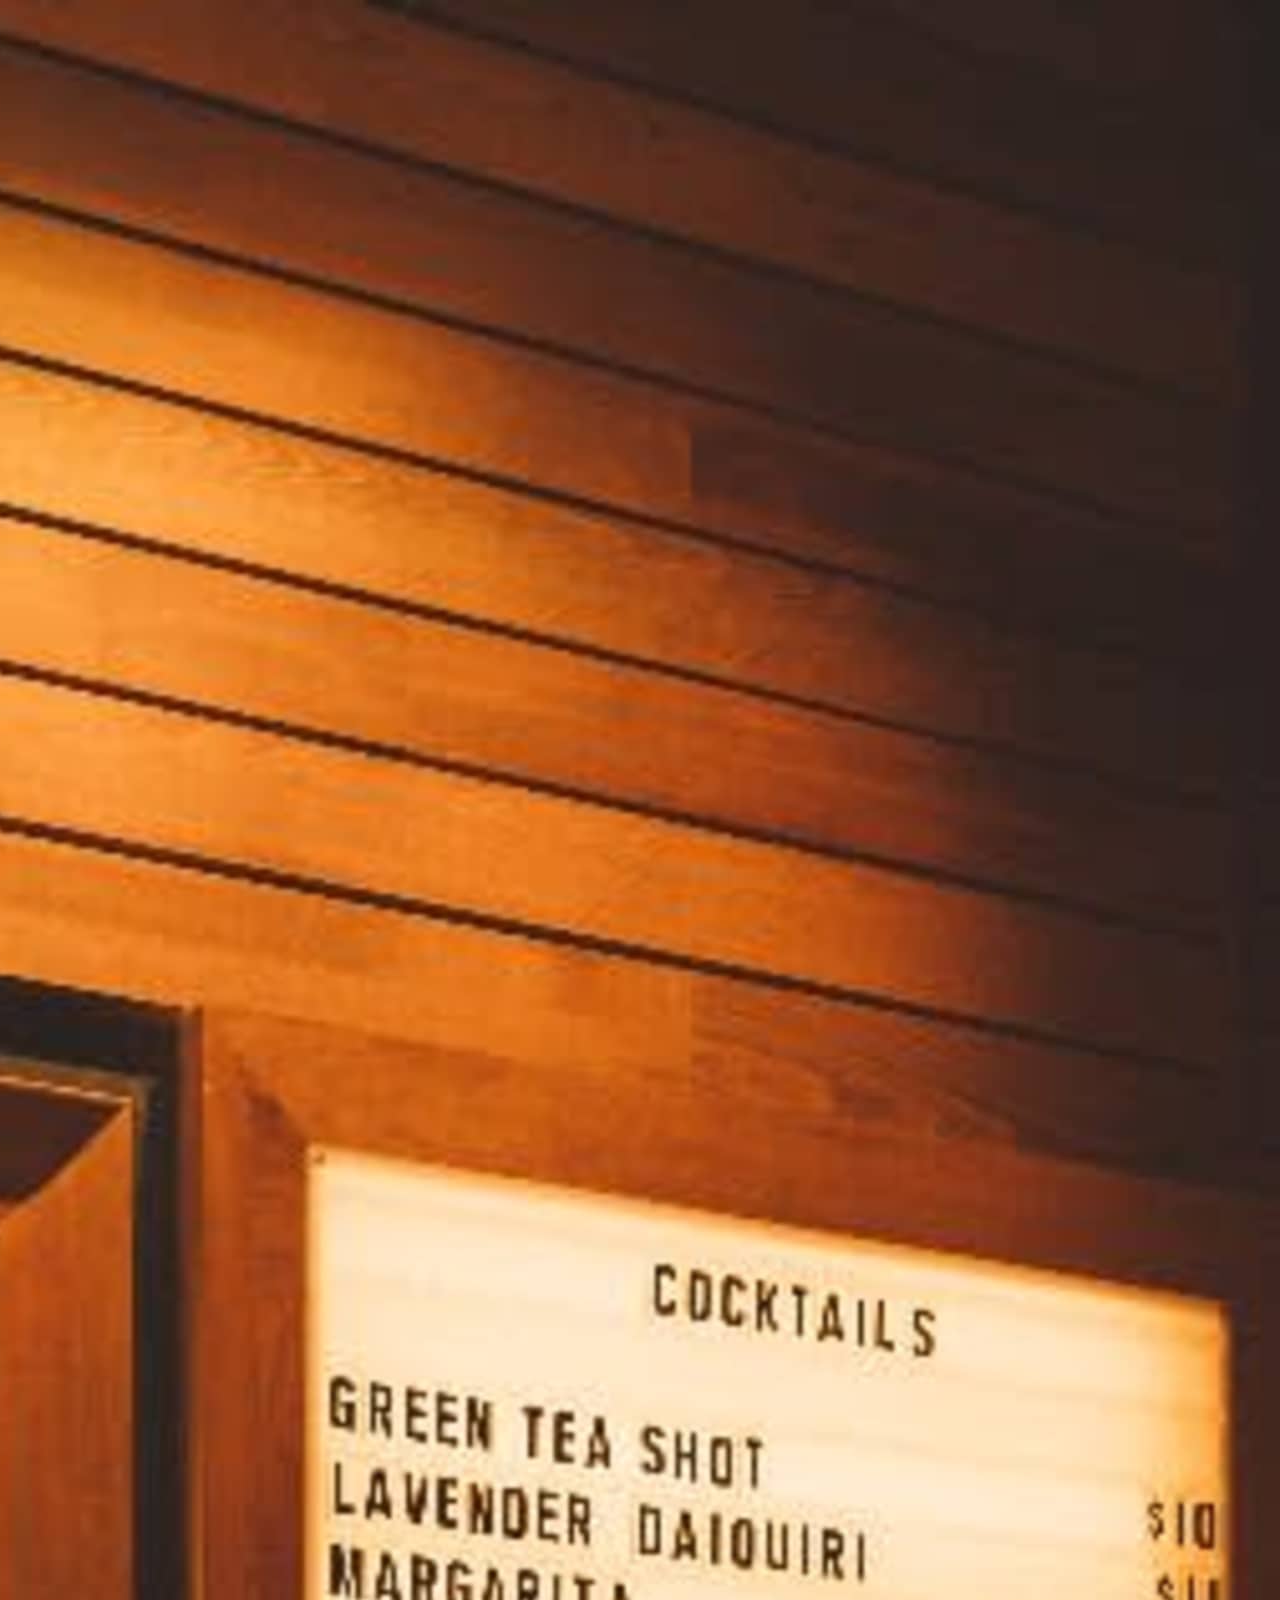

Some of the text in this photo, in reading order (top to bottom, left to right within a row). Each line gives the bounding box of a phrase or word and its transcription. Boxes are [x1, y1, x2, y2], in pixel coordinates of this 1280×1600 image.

[653, 1263, 936, 1358] COCKTAILS
[328, 1375, 1216, 1551] GREEN TEA SHOT $10
[333, 1461, 592, 1547] LAVENDER
